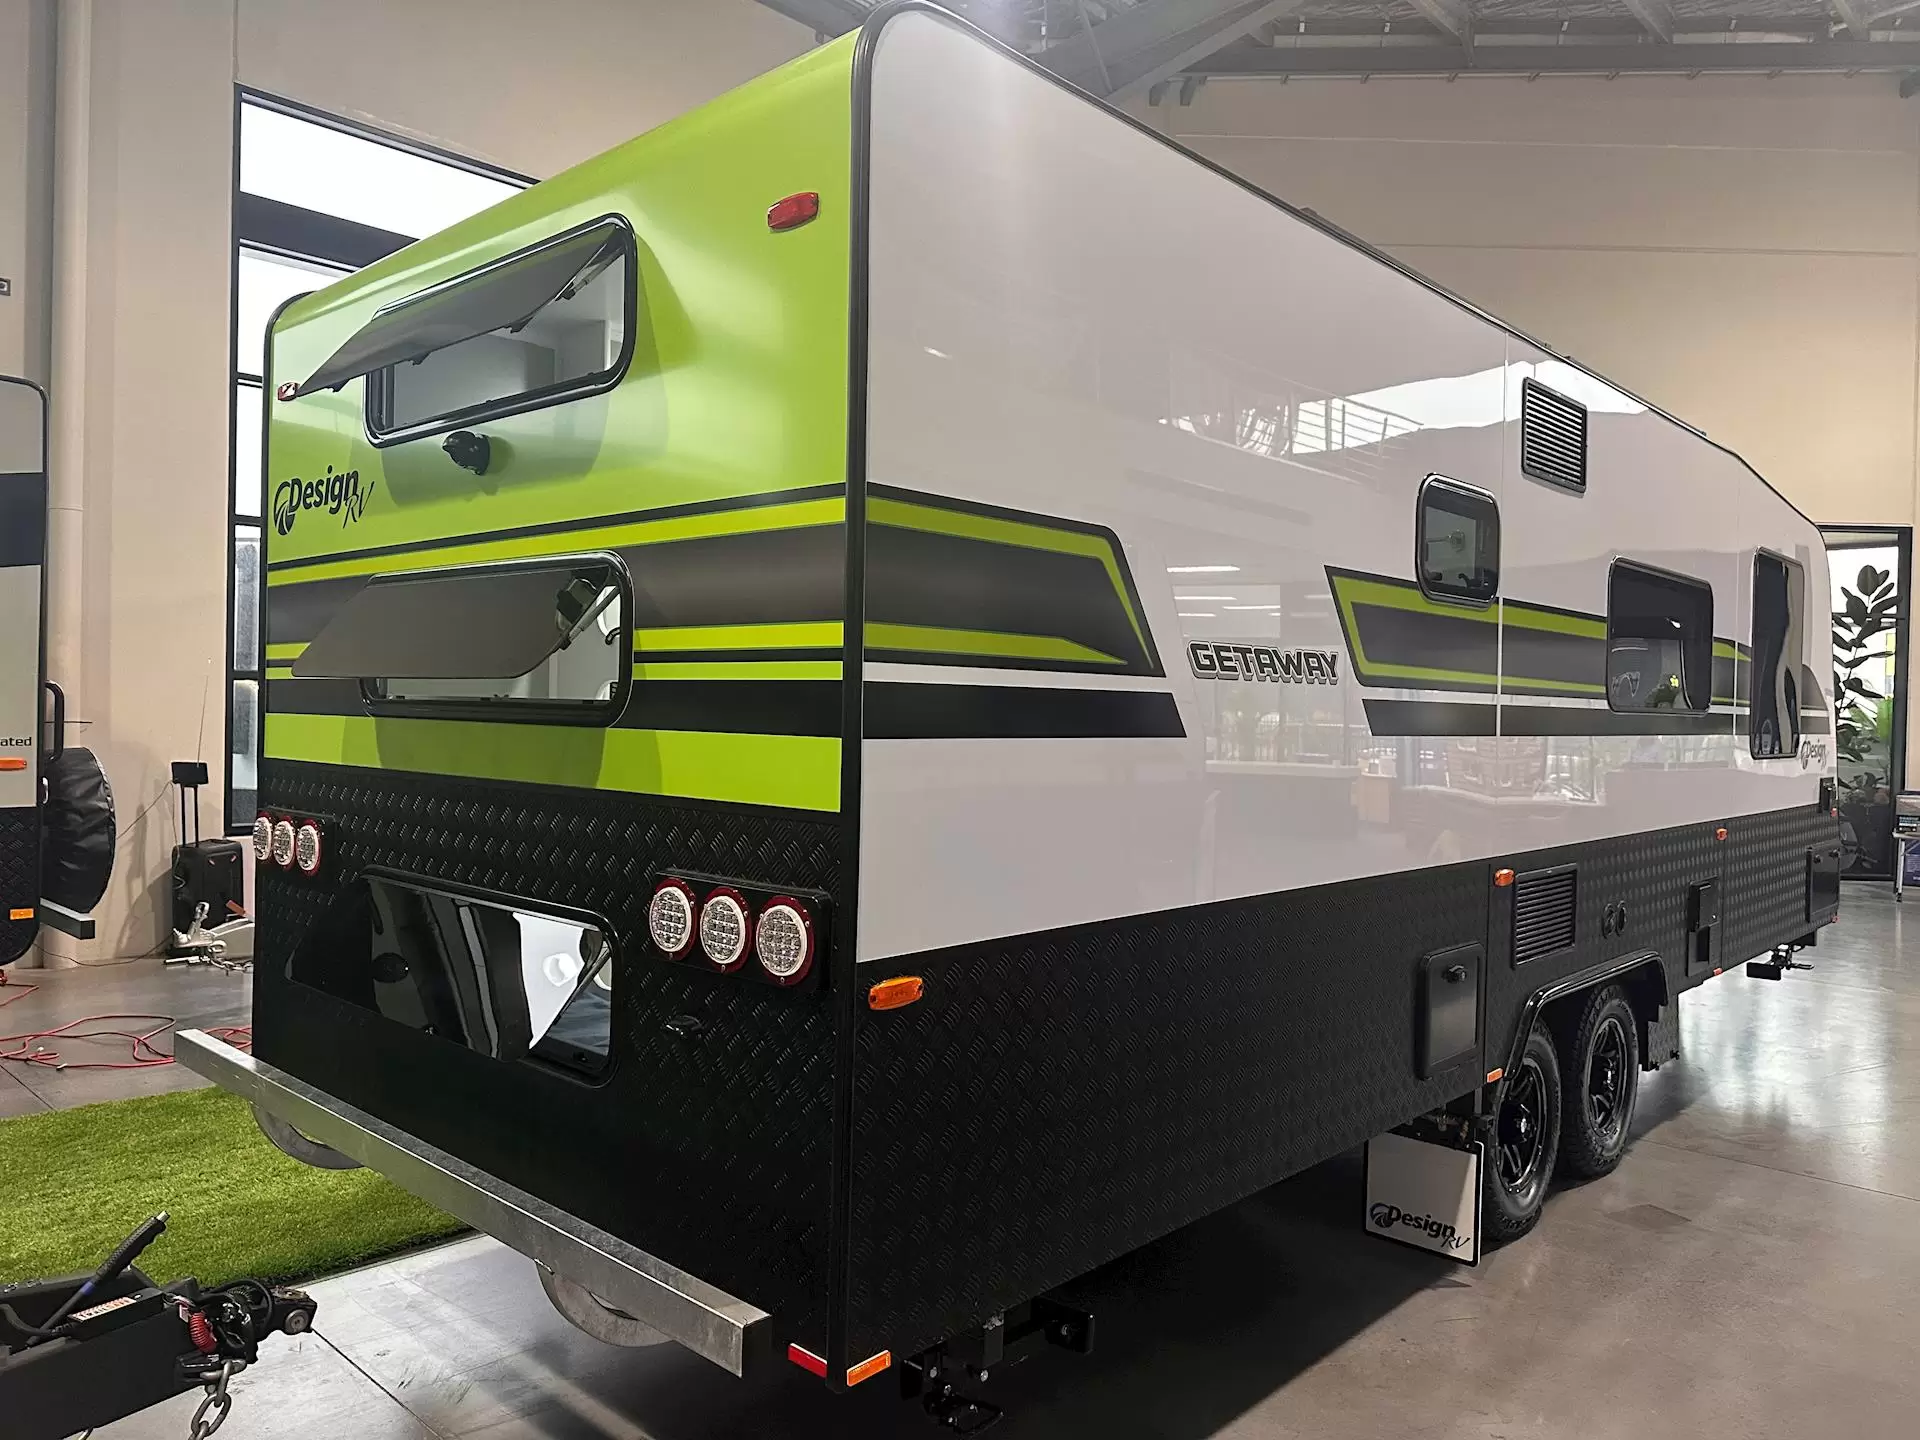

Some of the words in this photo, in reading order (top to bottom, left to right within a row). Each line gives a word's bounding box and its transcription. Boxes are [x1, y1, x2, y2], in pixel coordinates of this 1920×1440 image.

[289, 465, 359, 515] Design
[343, 481, 375, 529] RV
[1187, 640, 1339, 685] GETAWAY
[1387, 1205, 1456, 1240] Design
